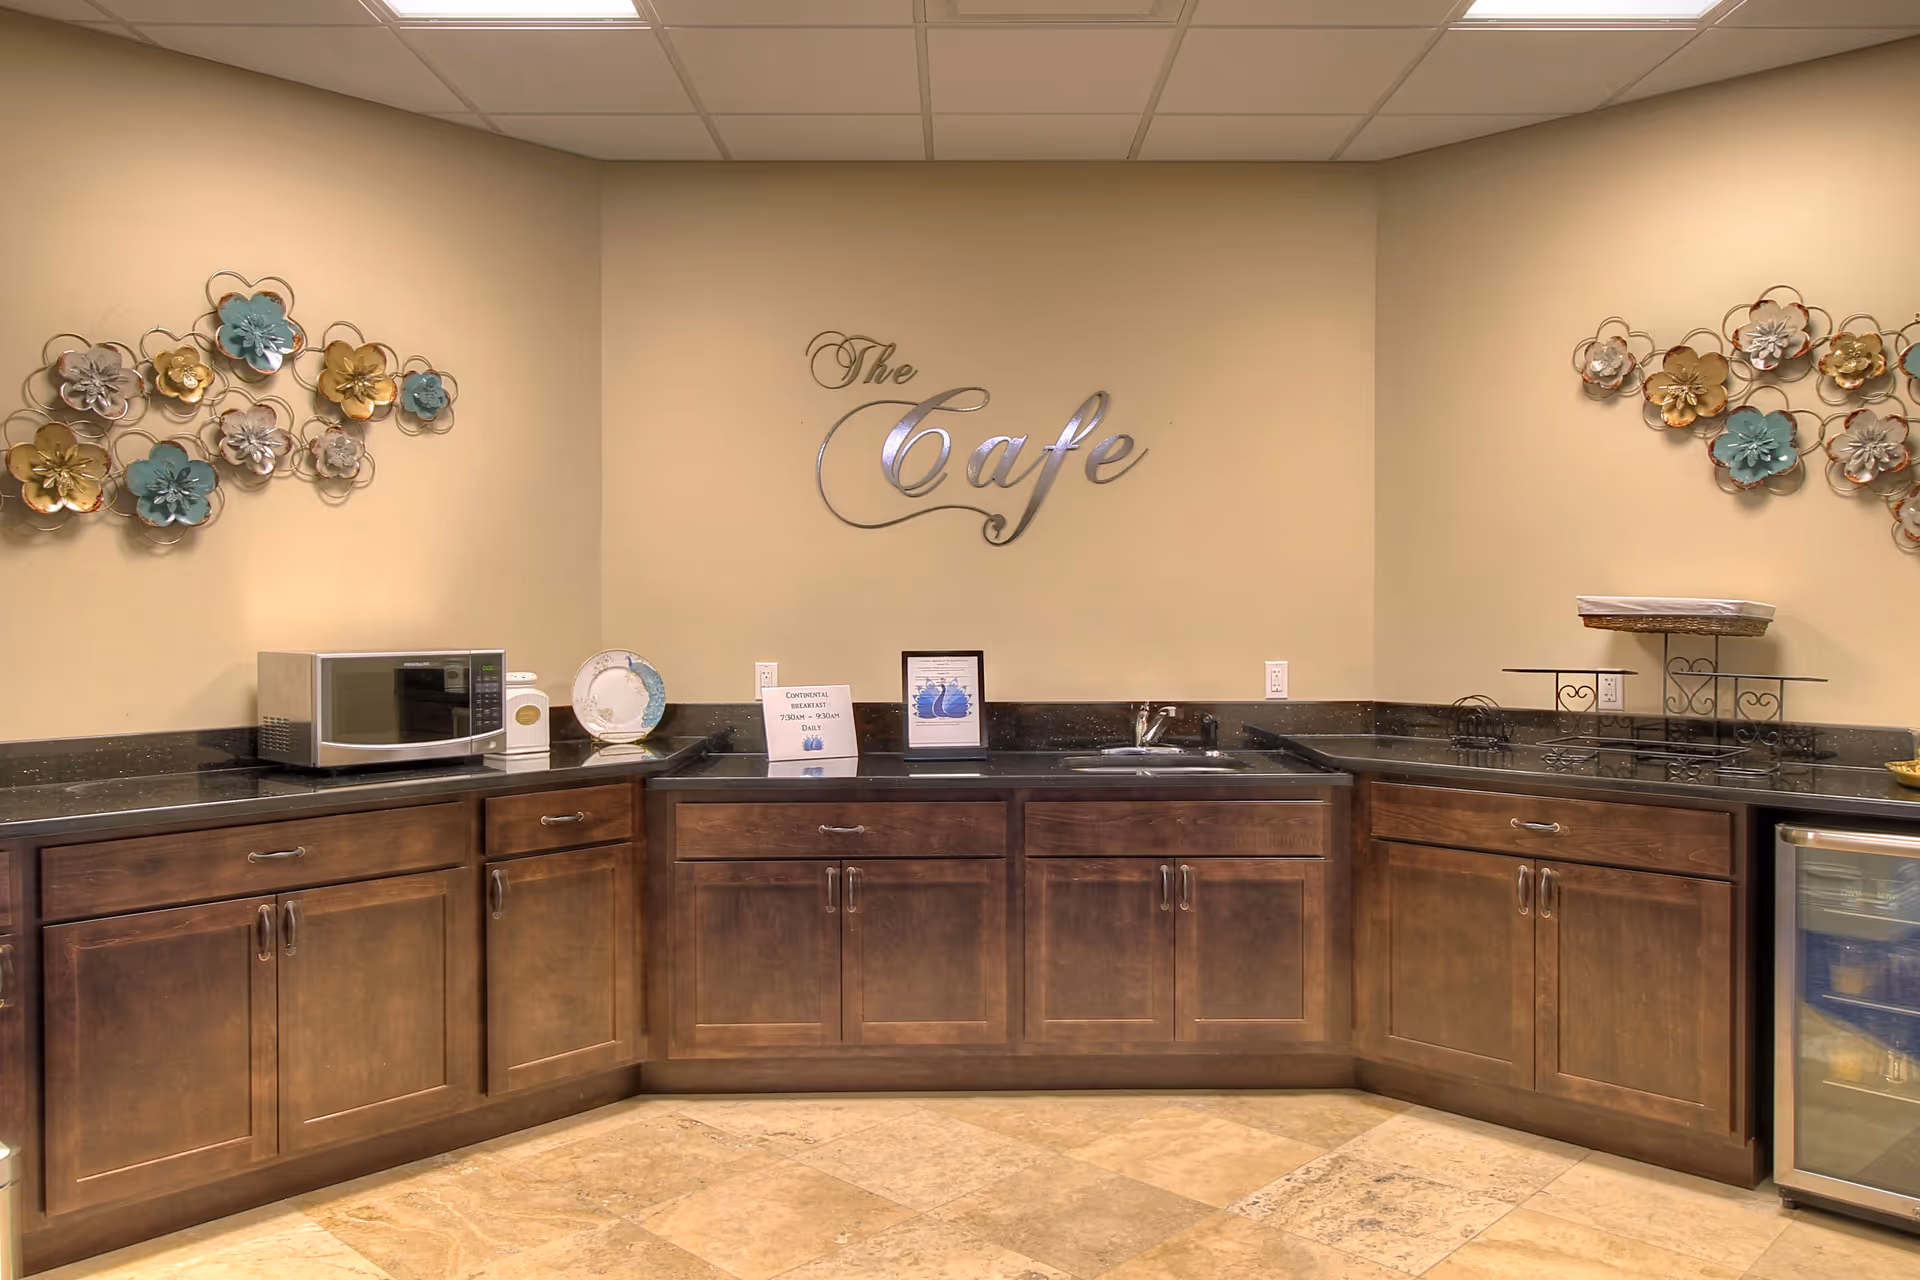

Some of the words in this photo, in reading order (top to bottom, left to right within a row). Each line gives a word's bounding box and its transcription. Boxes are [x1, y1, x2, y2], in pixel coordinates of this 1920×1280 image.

[805, 330, 918, 390] The
[816, 386, 1149, 547] Cafe
[785, 691, 829, 699] CONTINENTAL
